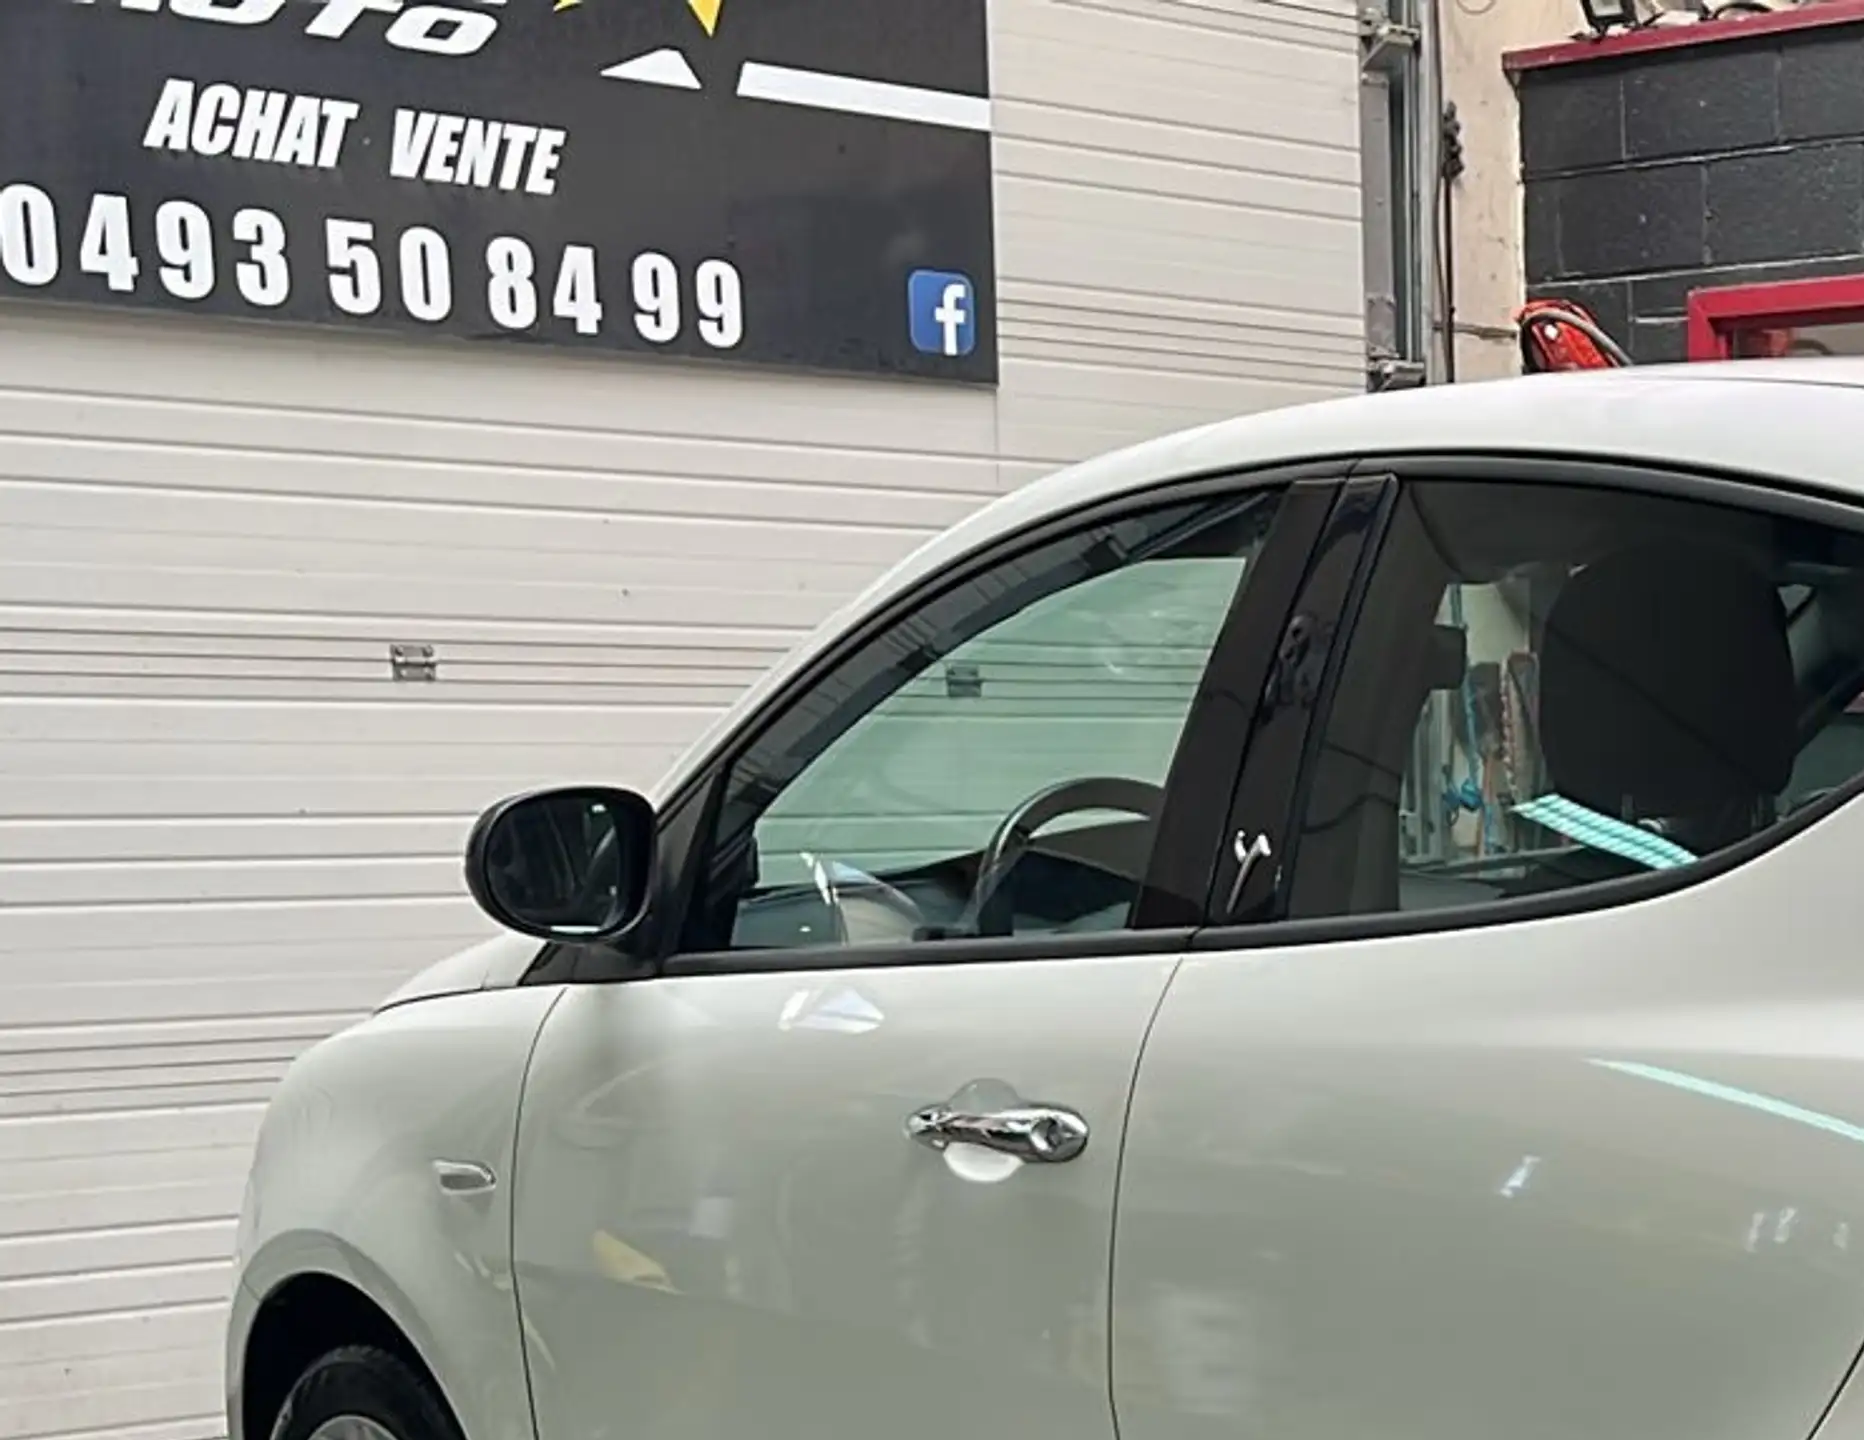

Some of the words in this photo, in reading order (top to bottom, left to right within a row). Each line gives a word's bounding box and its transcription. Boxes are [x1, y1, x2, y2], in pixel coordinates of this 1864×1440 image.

[143, 78, 360, 168] ACHAT
[390, 108, 567, 195] VENTE
[0, 183, 290, 306] 0493
[325, 217, 452, 322] 50
[486, 236, 602, 335] 84
[632, 251, 744, 348] 99
